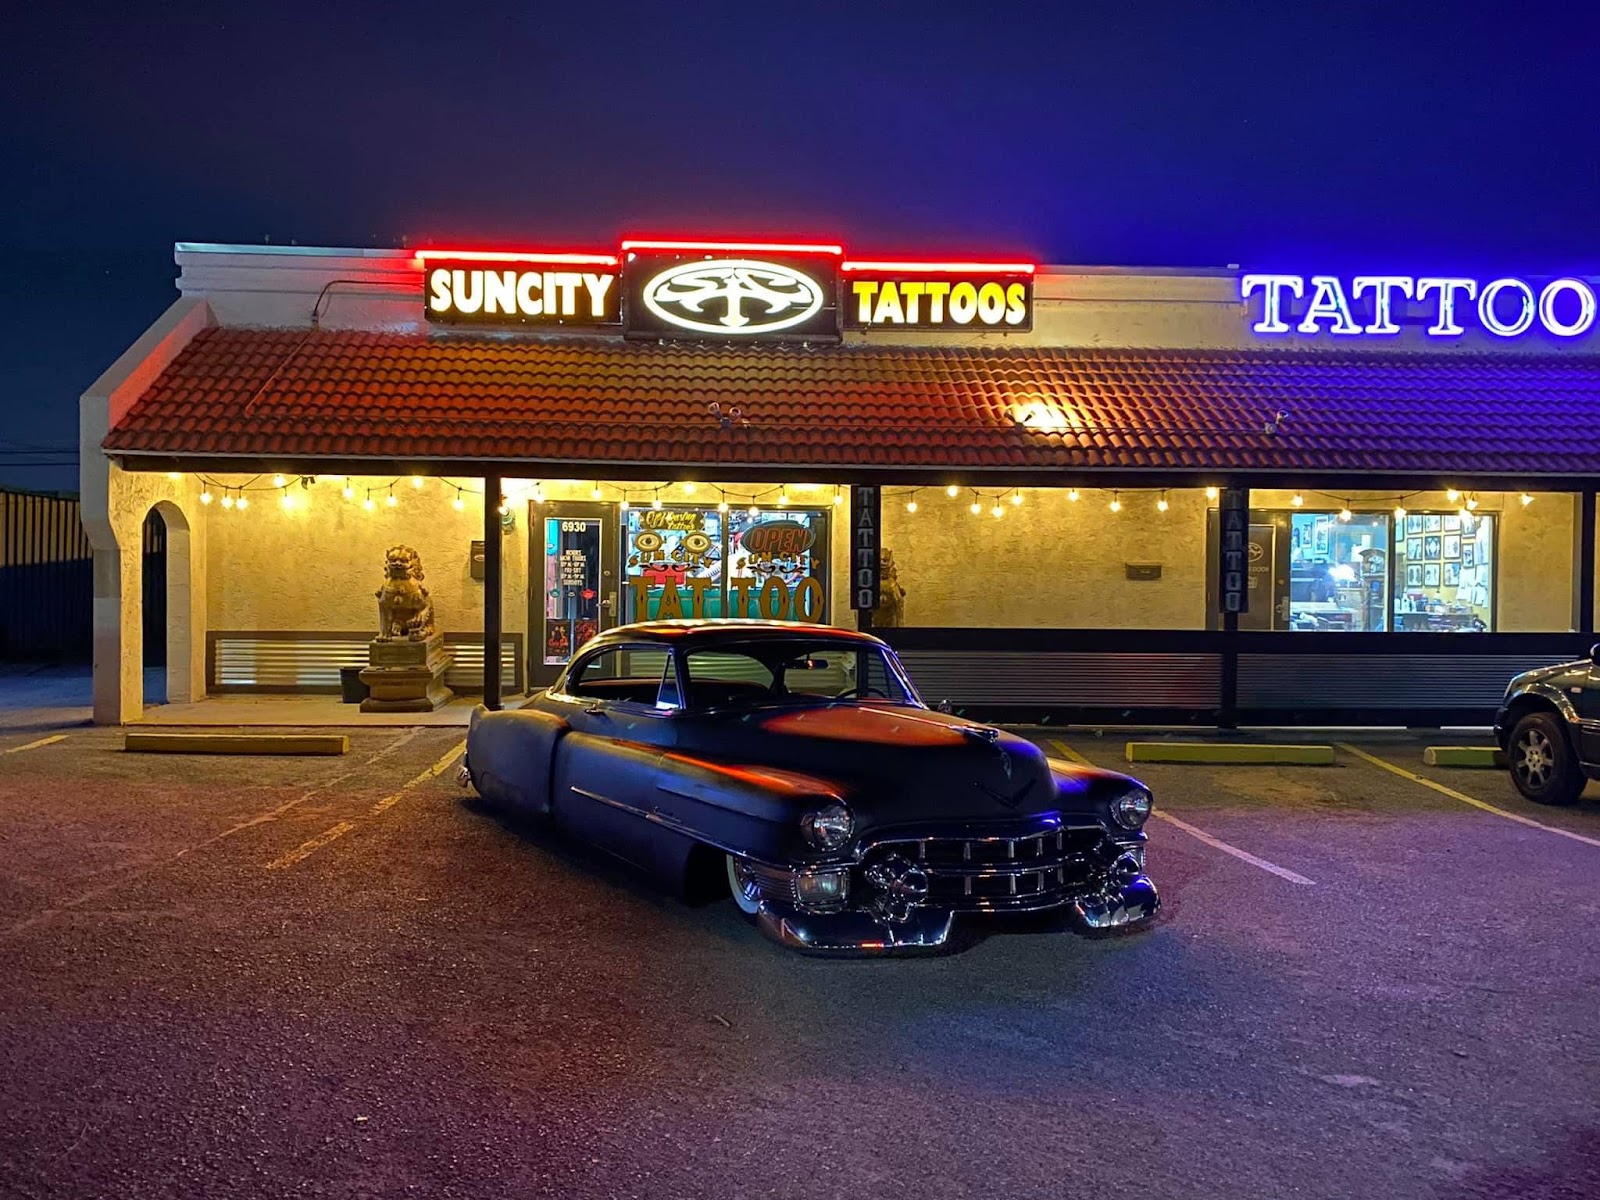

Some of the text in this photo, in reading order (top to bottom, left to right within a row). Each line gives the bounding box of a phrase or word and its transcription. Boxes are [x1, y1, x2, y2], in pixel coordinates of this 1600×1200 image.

[431, 269, 614, 317] SUNCITY
[853, 280, 1027, 326] TATTOOS
[1241, 274, 1597, 337] TATTOO
[562, 521, 586, 533] 6930
[750, 527, 808, 552] OPEN
[857, 487, 874, 608] TATTOO
[628, 550, 712, 568] SUN CITY
[736, 551, 820, 569] SUN CITY
[1225, 489, 1242, 612] TATTOO
